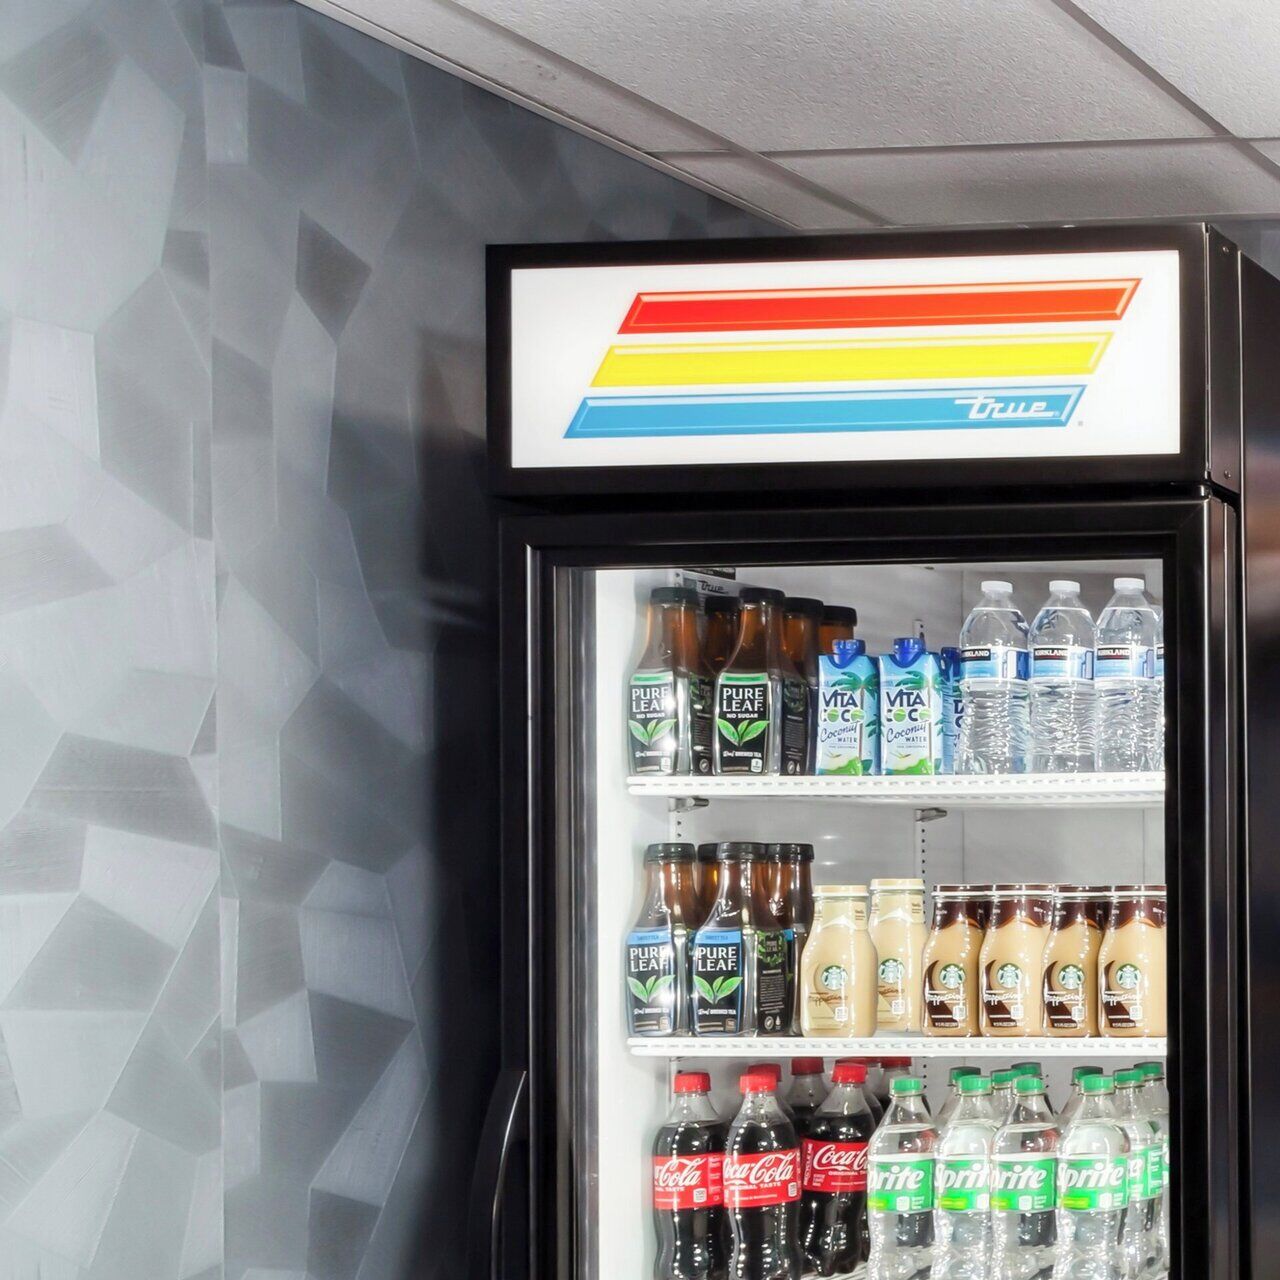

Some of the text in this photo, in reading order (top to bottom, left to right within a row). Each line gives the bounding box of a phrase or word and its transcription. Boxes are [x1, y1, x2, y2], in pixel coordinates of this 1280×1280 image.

[632, 687, 670, 699] PURE
[723, 687, 764, 699] PURE
[823, 689, 858, 708] VITA
[886, 689, 926, 708] VITA
[723, 700, 763, 712] LEAF
[821, 721, 858, 742] Coconut
[886, 721, 926, 743] Coconut
[699, 946, 737, 959] PURE
[698, 959, 737, 971] LEAF
[724, 1153, 796, 1185] oca-Cola
[1057, 1162, 1126, 1193] Sprite
